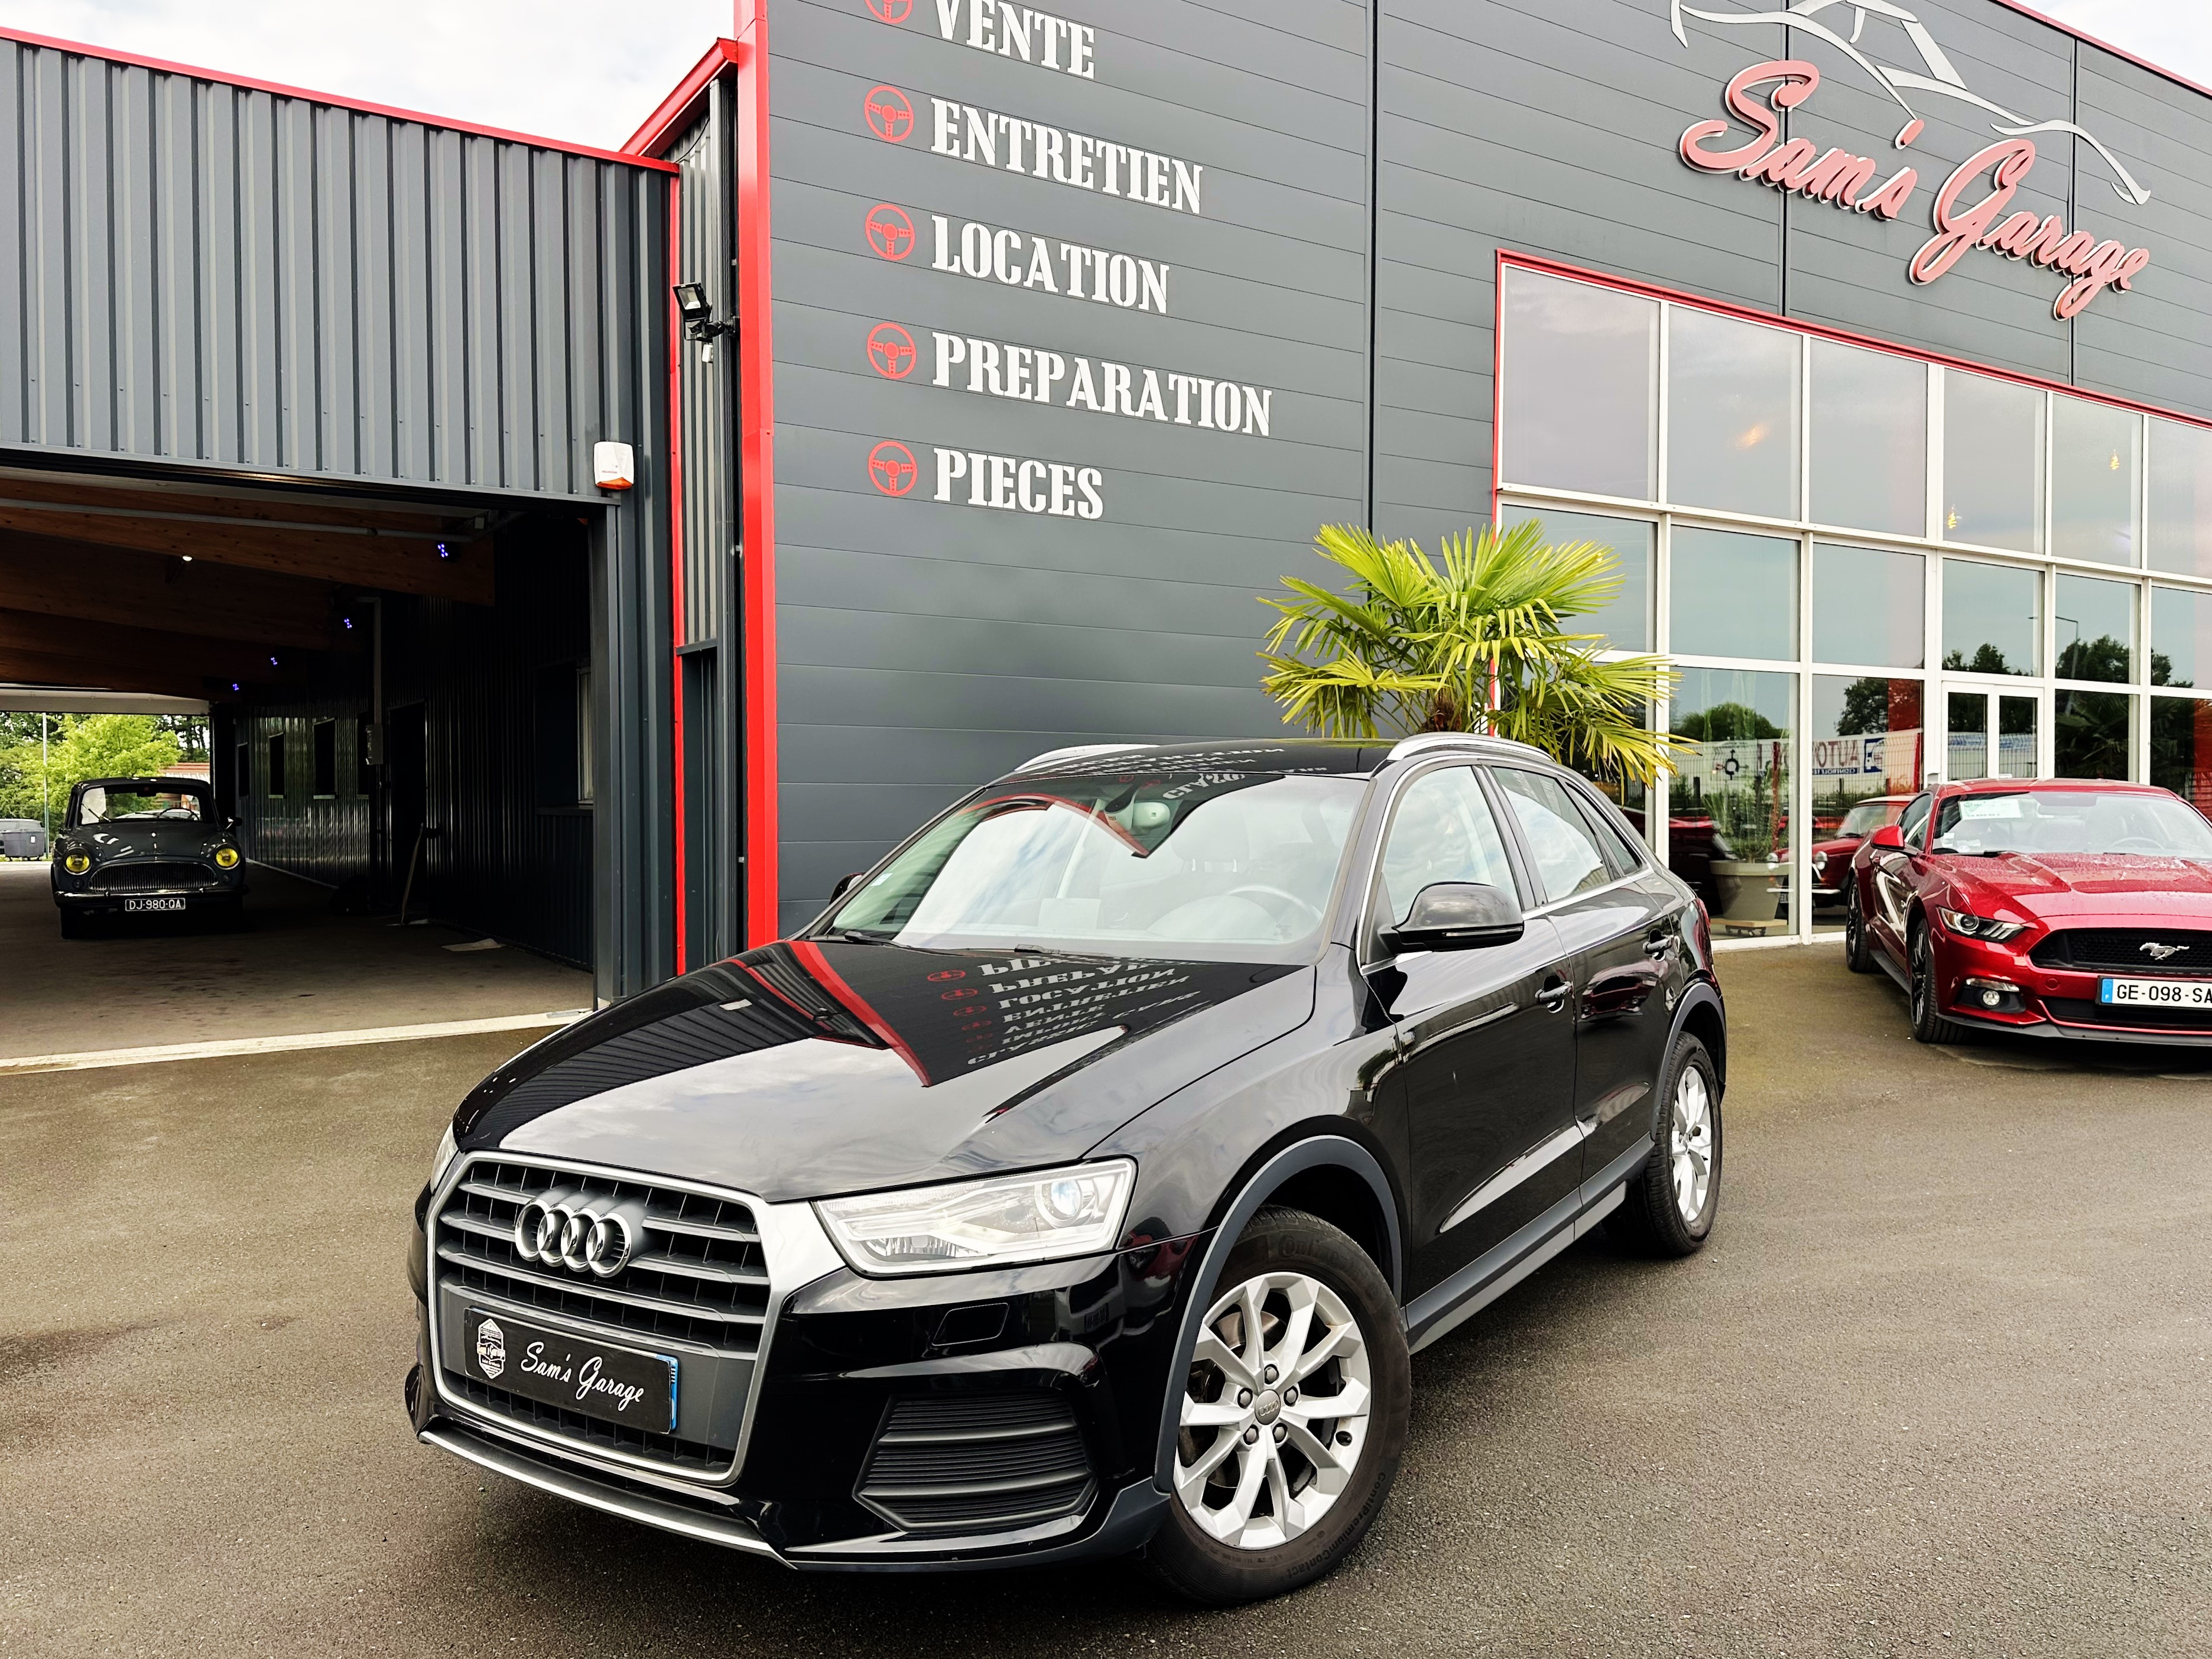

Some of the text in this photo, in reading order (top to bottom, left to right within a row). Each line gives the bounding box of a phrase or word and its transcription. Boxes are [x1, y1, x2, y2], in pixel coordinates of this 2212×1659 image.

[937, 0, 1094, 79] VENTE
[931, 98, 1203, 214] ENTRETIEN
[1680, 60, 2149, 322] Sam's Garage
[931, 215, 1170, 314] LOCATION
[932, 332, 1272, 436] PREPARATION
[934, 447, 1103, 520] PIECES
[129, 898, 181, 910] DJ-980-QA
[521, 1341, 571, 1383] Sam's
[576, 1356, 644, 1411] Garage
